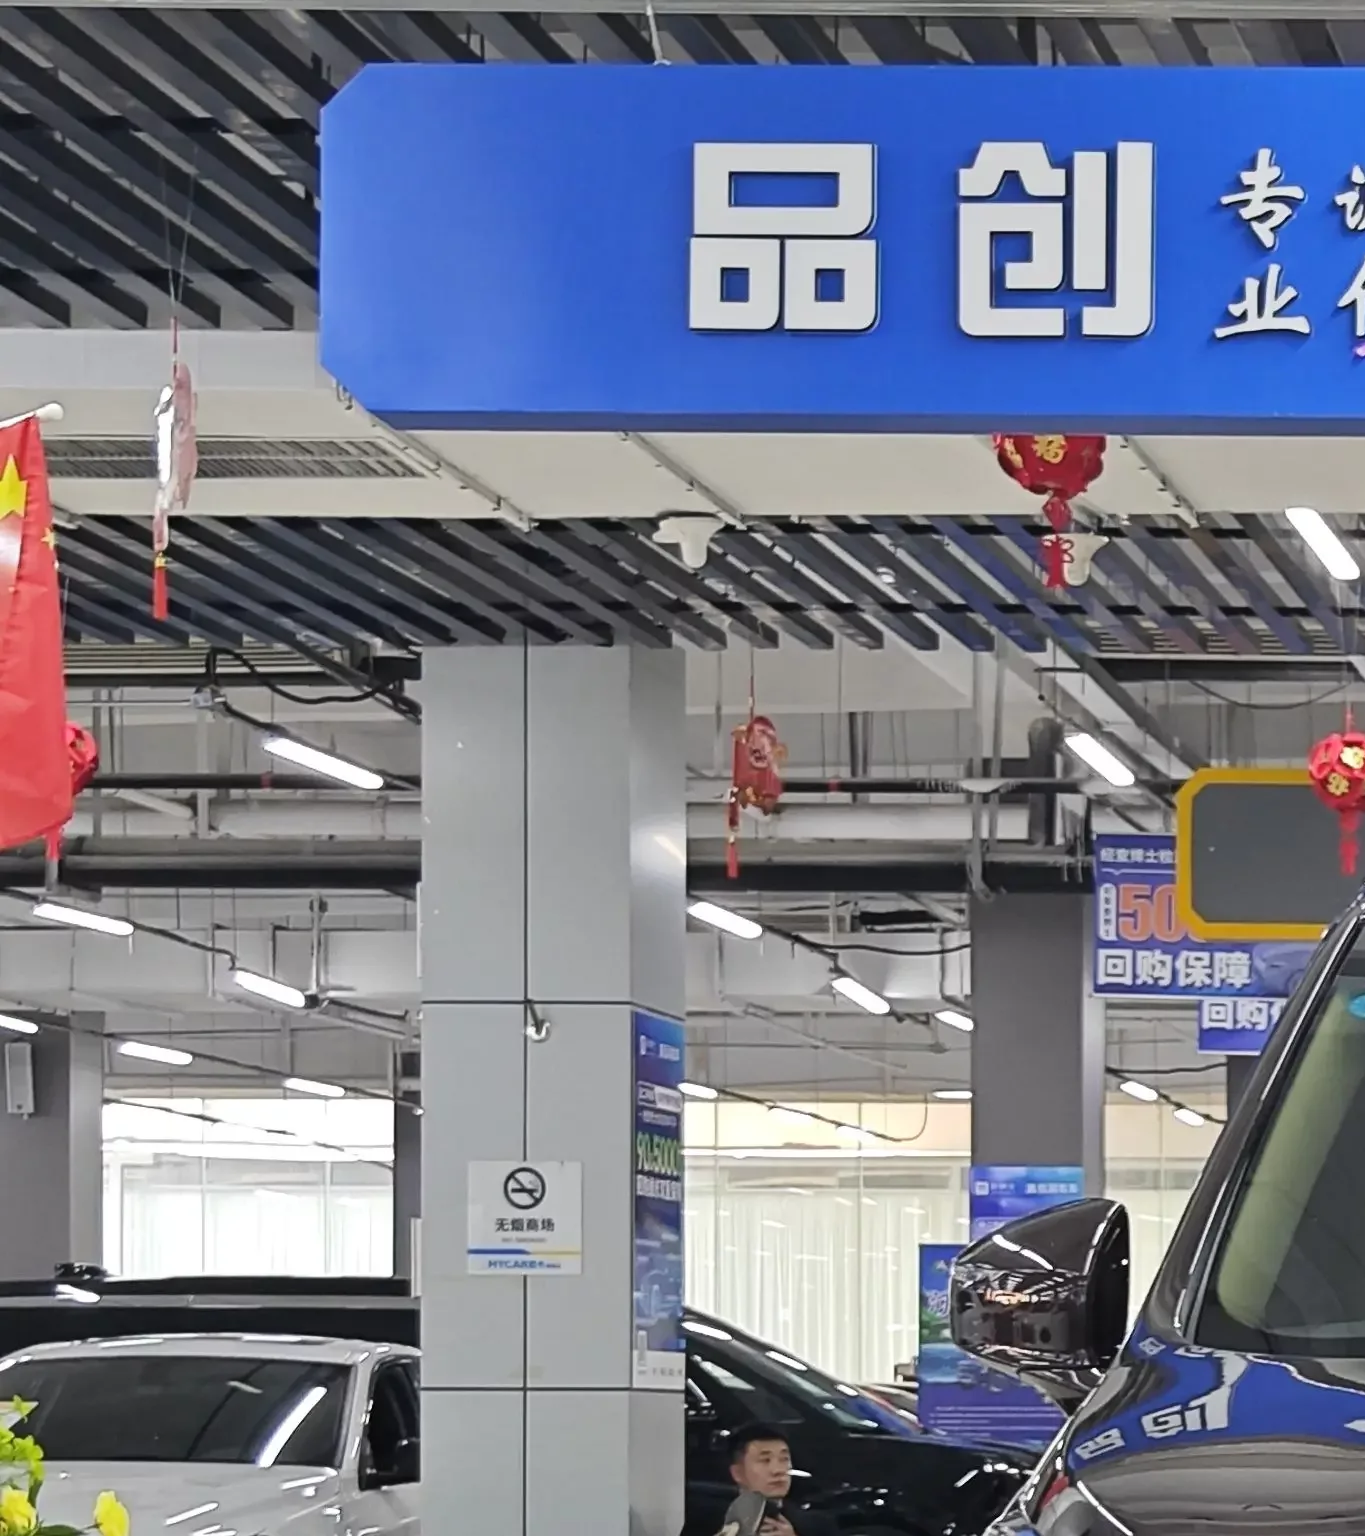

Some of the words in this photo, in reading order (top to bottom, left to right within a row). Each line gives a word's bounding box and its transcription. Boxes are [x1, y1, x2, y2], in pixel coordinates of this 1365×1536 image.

[688, 141, 1156, 338] 品创
[1118, 883, 1206, 943] 50
[1096, 948, 1252, 990] 回购保障
[494, 1217, 556, 1233] 无烟商场
